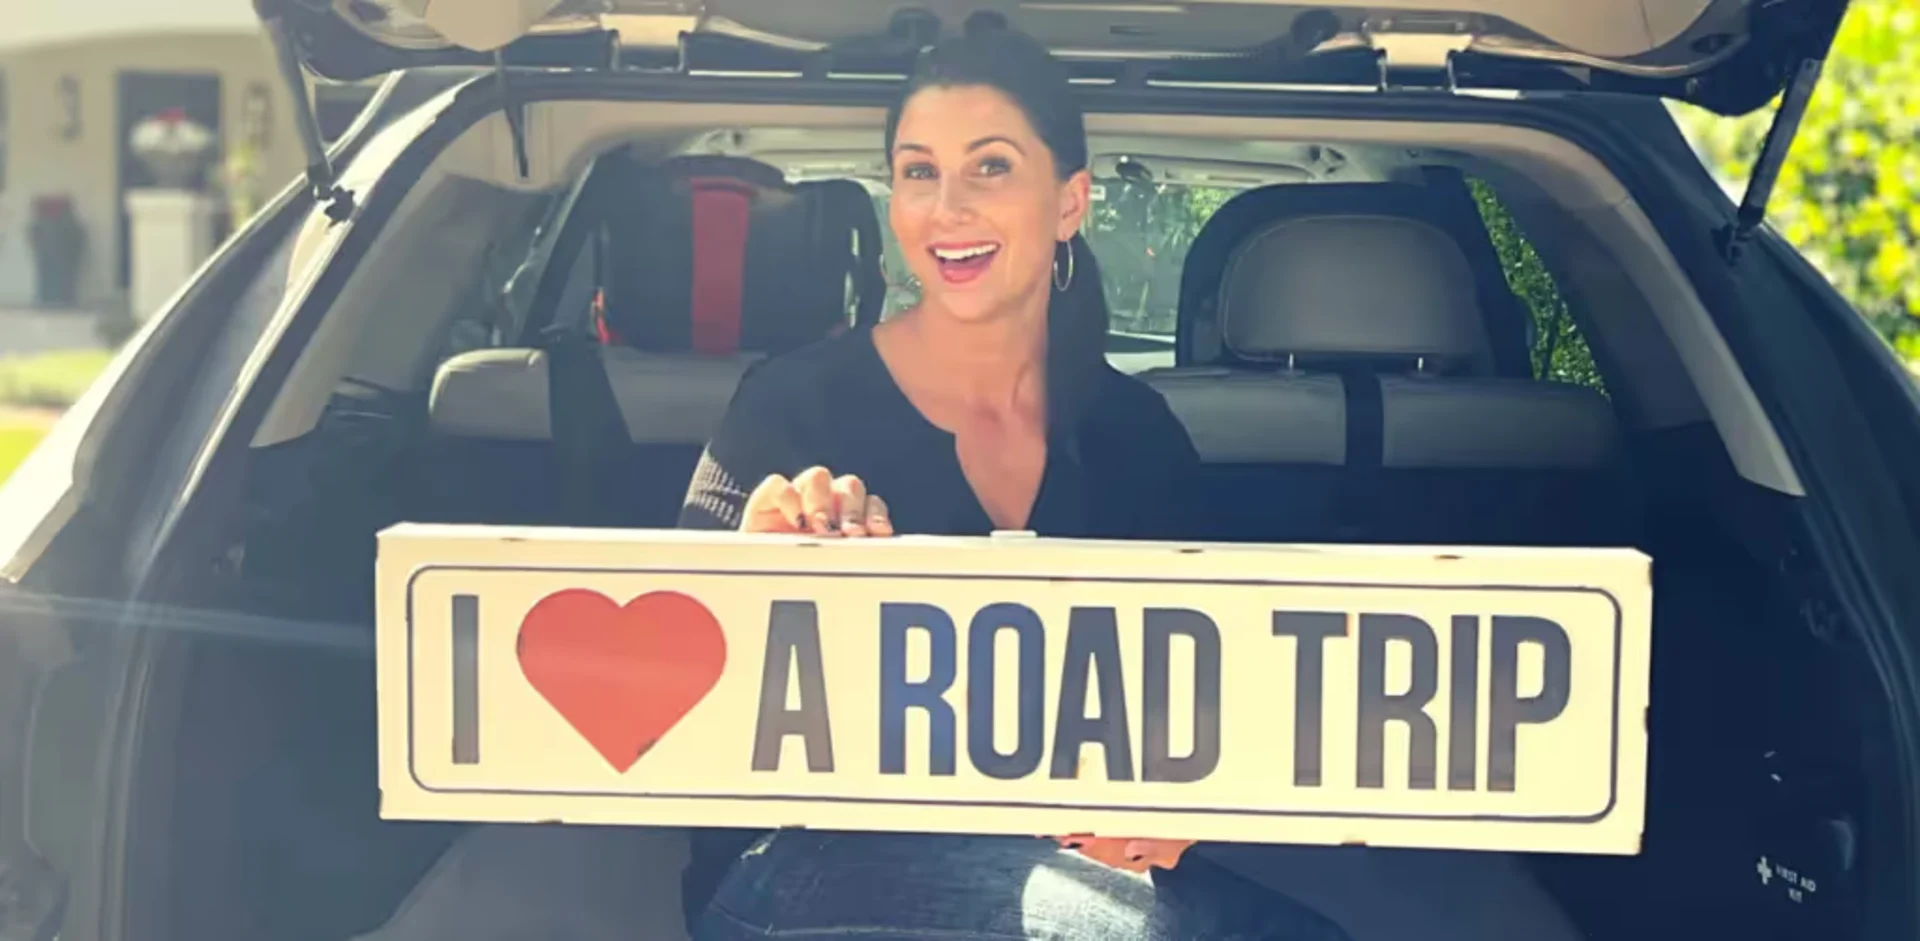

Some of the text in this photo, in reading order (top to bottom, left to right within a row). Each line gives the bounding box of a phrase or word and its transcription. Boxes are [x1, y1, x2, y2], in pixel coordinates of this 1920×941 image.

[451, 594, 1572, 792] I A ROAD TRIP
[1800, 876, 1817, 893] AID
